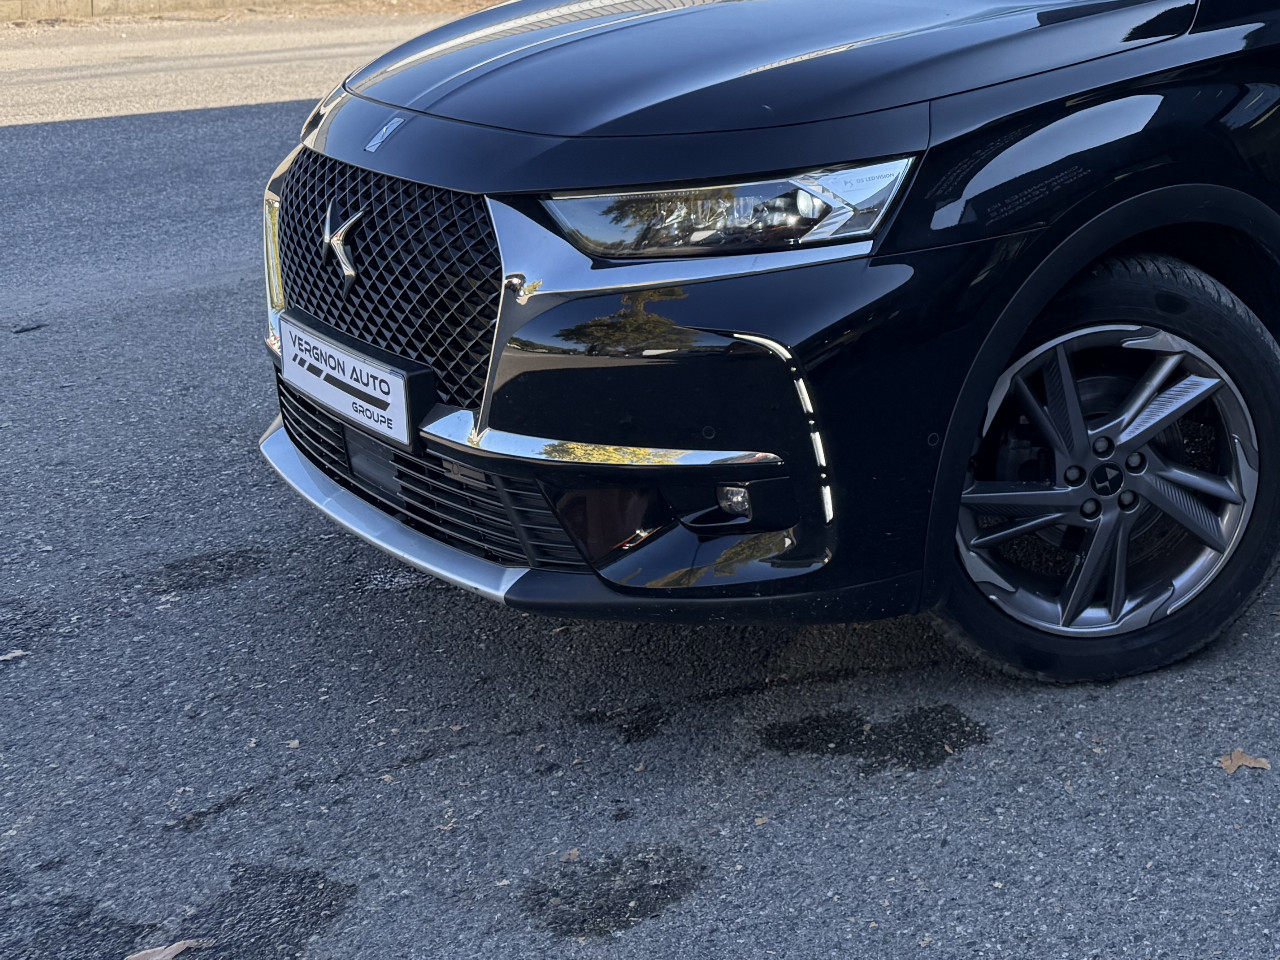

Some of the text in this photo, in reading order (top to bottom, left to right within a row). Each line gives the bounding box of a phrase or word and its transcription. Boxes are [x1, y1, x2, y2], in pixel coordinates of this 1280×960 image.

[289, 330, 391, 396] VERGNON AUTO
[351, 401, 393, 430] GROUPE
